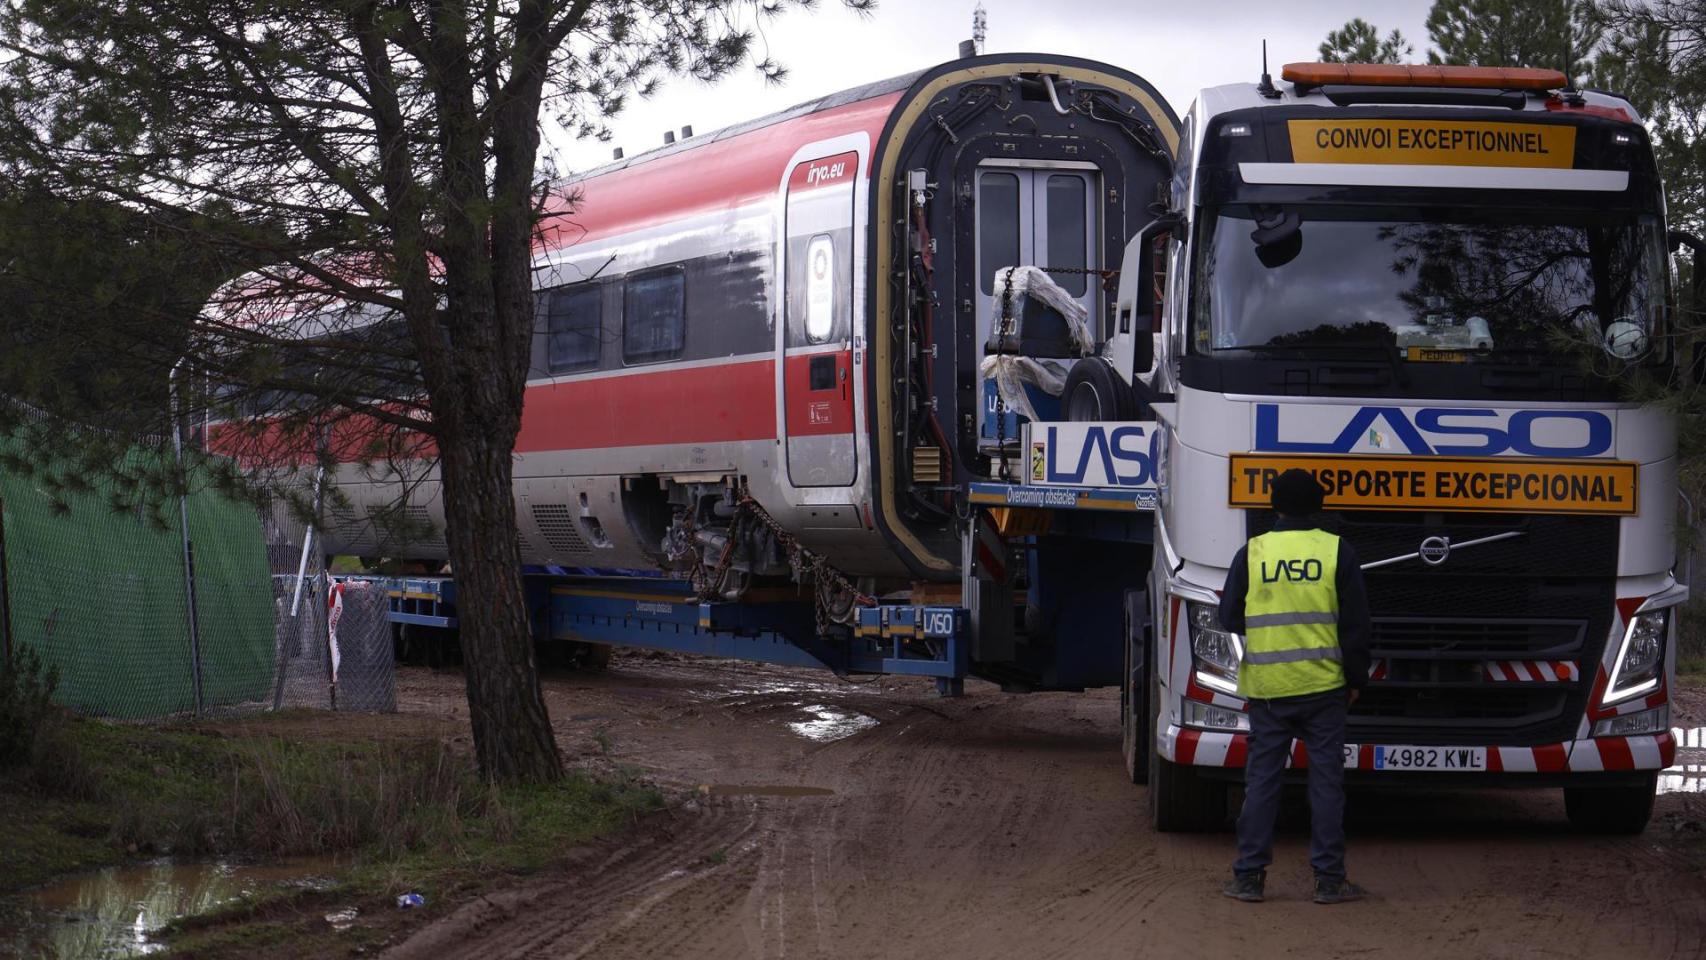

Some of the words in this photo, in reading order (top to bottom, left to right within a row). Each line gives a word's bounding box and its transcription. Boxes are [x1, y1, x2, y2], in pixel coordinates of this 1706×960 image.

[1316, 128, 1391, 149] CONVOI
[1399, 128, 1549, 154] EXCEPTIONNEL
[807, 162, 845, 187] iryo.eu
[1255, 404, 1612, 456] LASO
[1007, 487, 1044, 507] Overcoming
[1045, 488, 1076, 505] obstacles
[1244, 468, 1426, 498] TRSPORTE
[1435, 471, 1623, 503] EXCEPCIONAL
[1261, 558, 1322, 583] LASO
[923, 613, 953, 634] LASO
[1388, 749, 1438, 768] 4982
[1444, 749, 1481, 768] KWL
